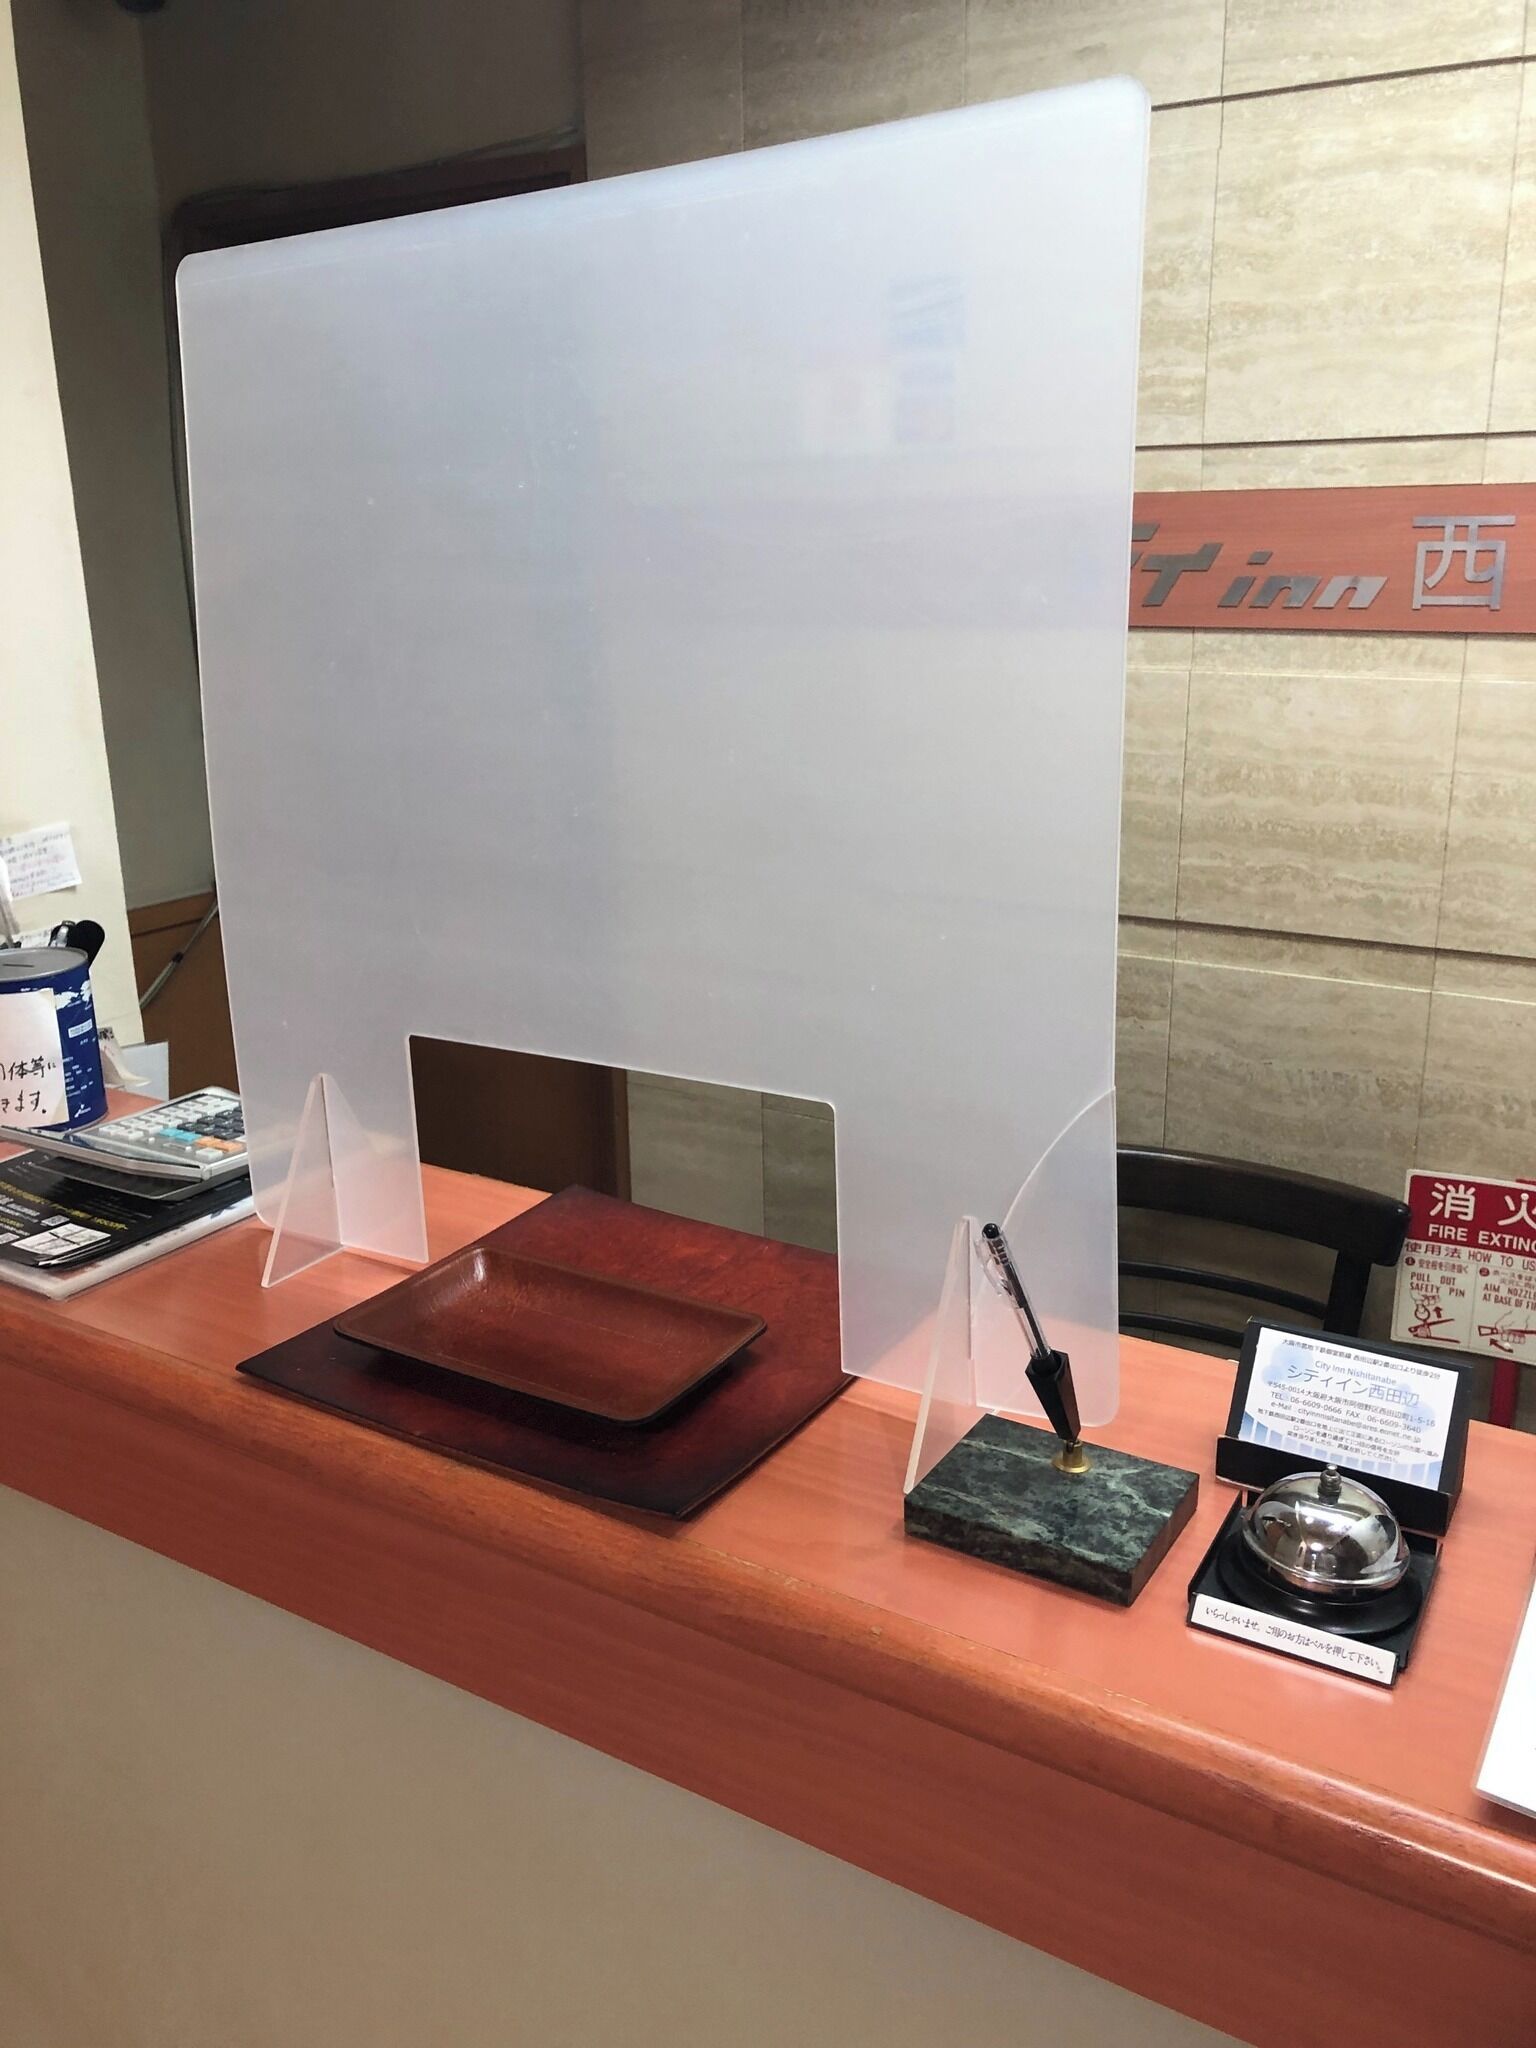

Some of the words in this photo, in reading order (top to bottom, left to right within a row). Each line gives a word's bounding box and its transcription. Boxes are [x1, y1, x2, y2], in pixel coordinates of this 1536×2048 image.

[1412, 515, 1516, 610] 西
[1217, 551, 1388, 609] inn
[1428, 1223, 1468, 1241] FIRE
[1405, 1241, 1462, 1259] 使用法
[1468, 1250, 1492, 1263] HOW
[1500, 1255, 1514, 1268] TO
[1410, 1272, 1430, 1283] PULL
[1440, 1276, 1456, 1286] OUT
[1483, 1283, 1500, 1293] AIM
[1410, 1282, 1440, 1294] SAFETY
[1449, 1287, 1466, 1298] PIN
[1483, 1293, 1491, 1302] AT
[1494, 1294, 1512, 1306] BASE
[1315, 1360, 1331, 1372] City
[1332, 1362, 1346, 1375] Inn
[1348, 1366, 1396, 1386] Nishitanabe
[1287, 1363, 1420, 1408] シティイン西田辺
